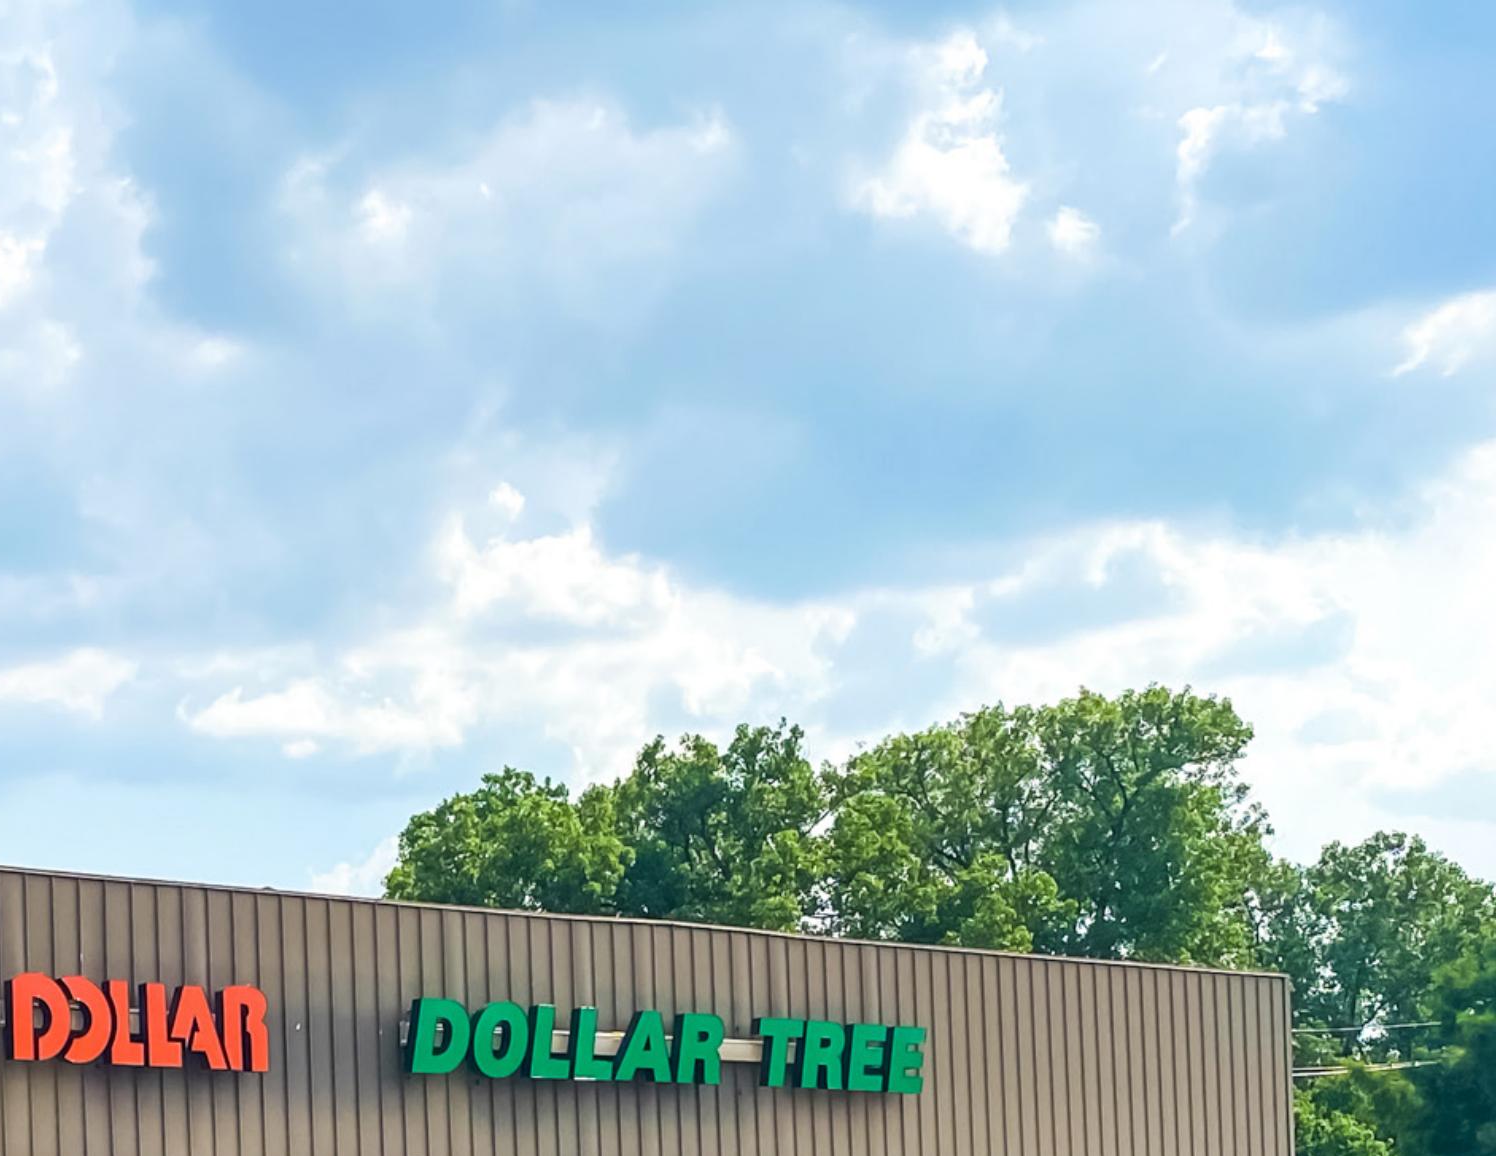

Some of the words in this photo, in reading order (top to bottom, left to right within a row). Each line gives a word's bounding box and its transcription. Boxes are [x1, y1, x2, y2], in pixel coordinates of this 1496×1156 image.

[6, 972, 270, 1073] DOLLAR
[408, 996, 726, 1086] DOLLAR
[752, 1016, 927, 1095] TREE
